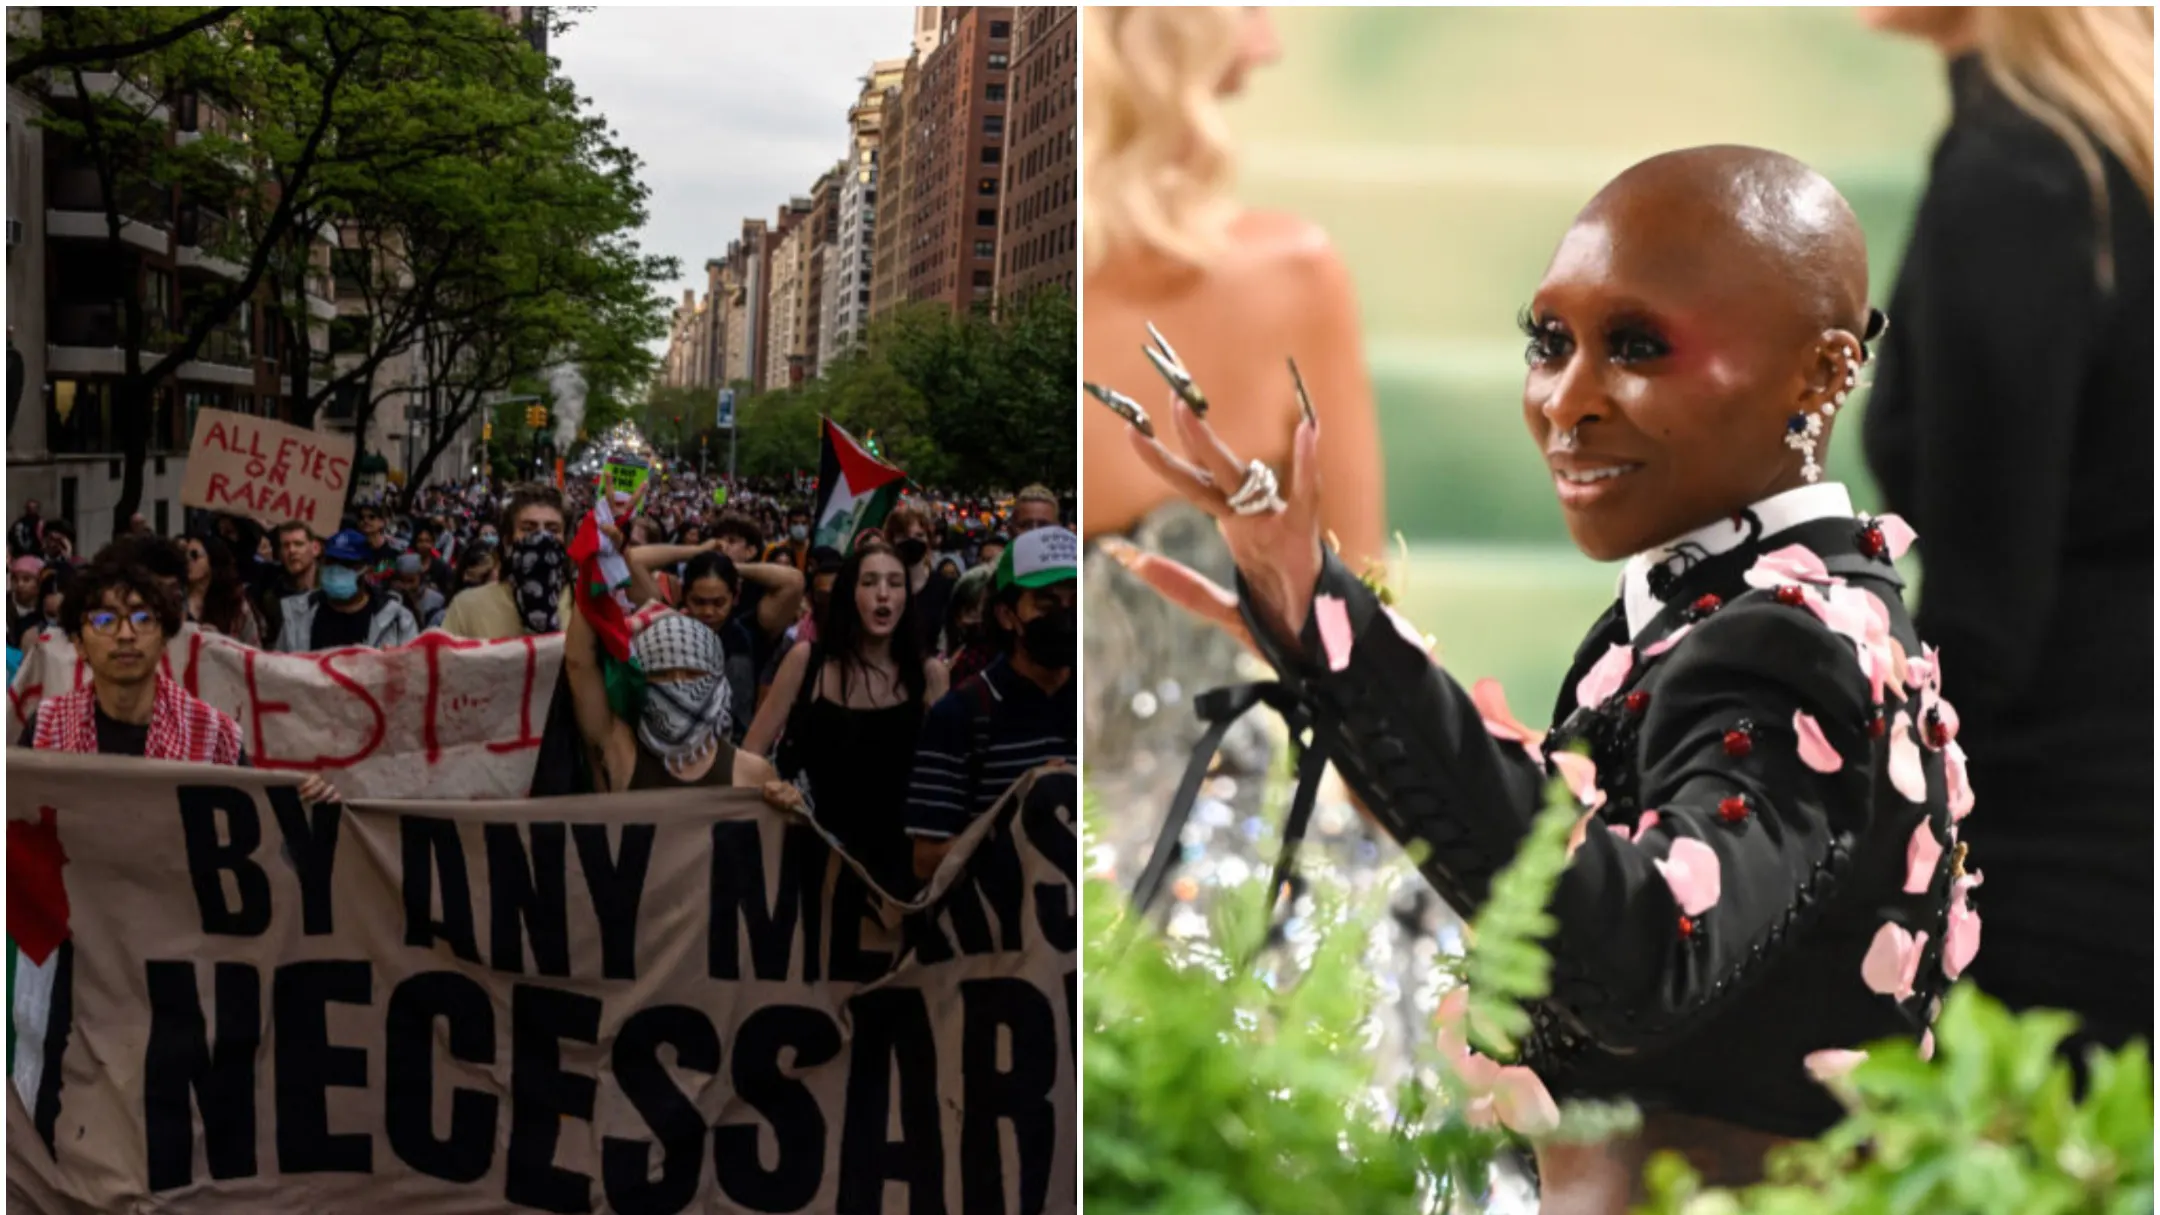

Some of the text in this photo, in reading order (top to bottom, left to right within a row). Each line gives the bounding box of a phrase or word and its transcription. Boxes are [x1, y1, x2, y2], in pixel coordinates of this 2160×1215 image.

[203, 421, 350, 492] ALL EYES
[245, 459, 289, 487] ON
[205, 472, 318, 522] RAFAH
[176, 783, 343, 937] BY
[401, 815, 657, 980] ANY
[145, 959, 1077, 1215] NECESSAR
